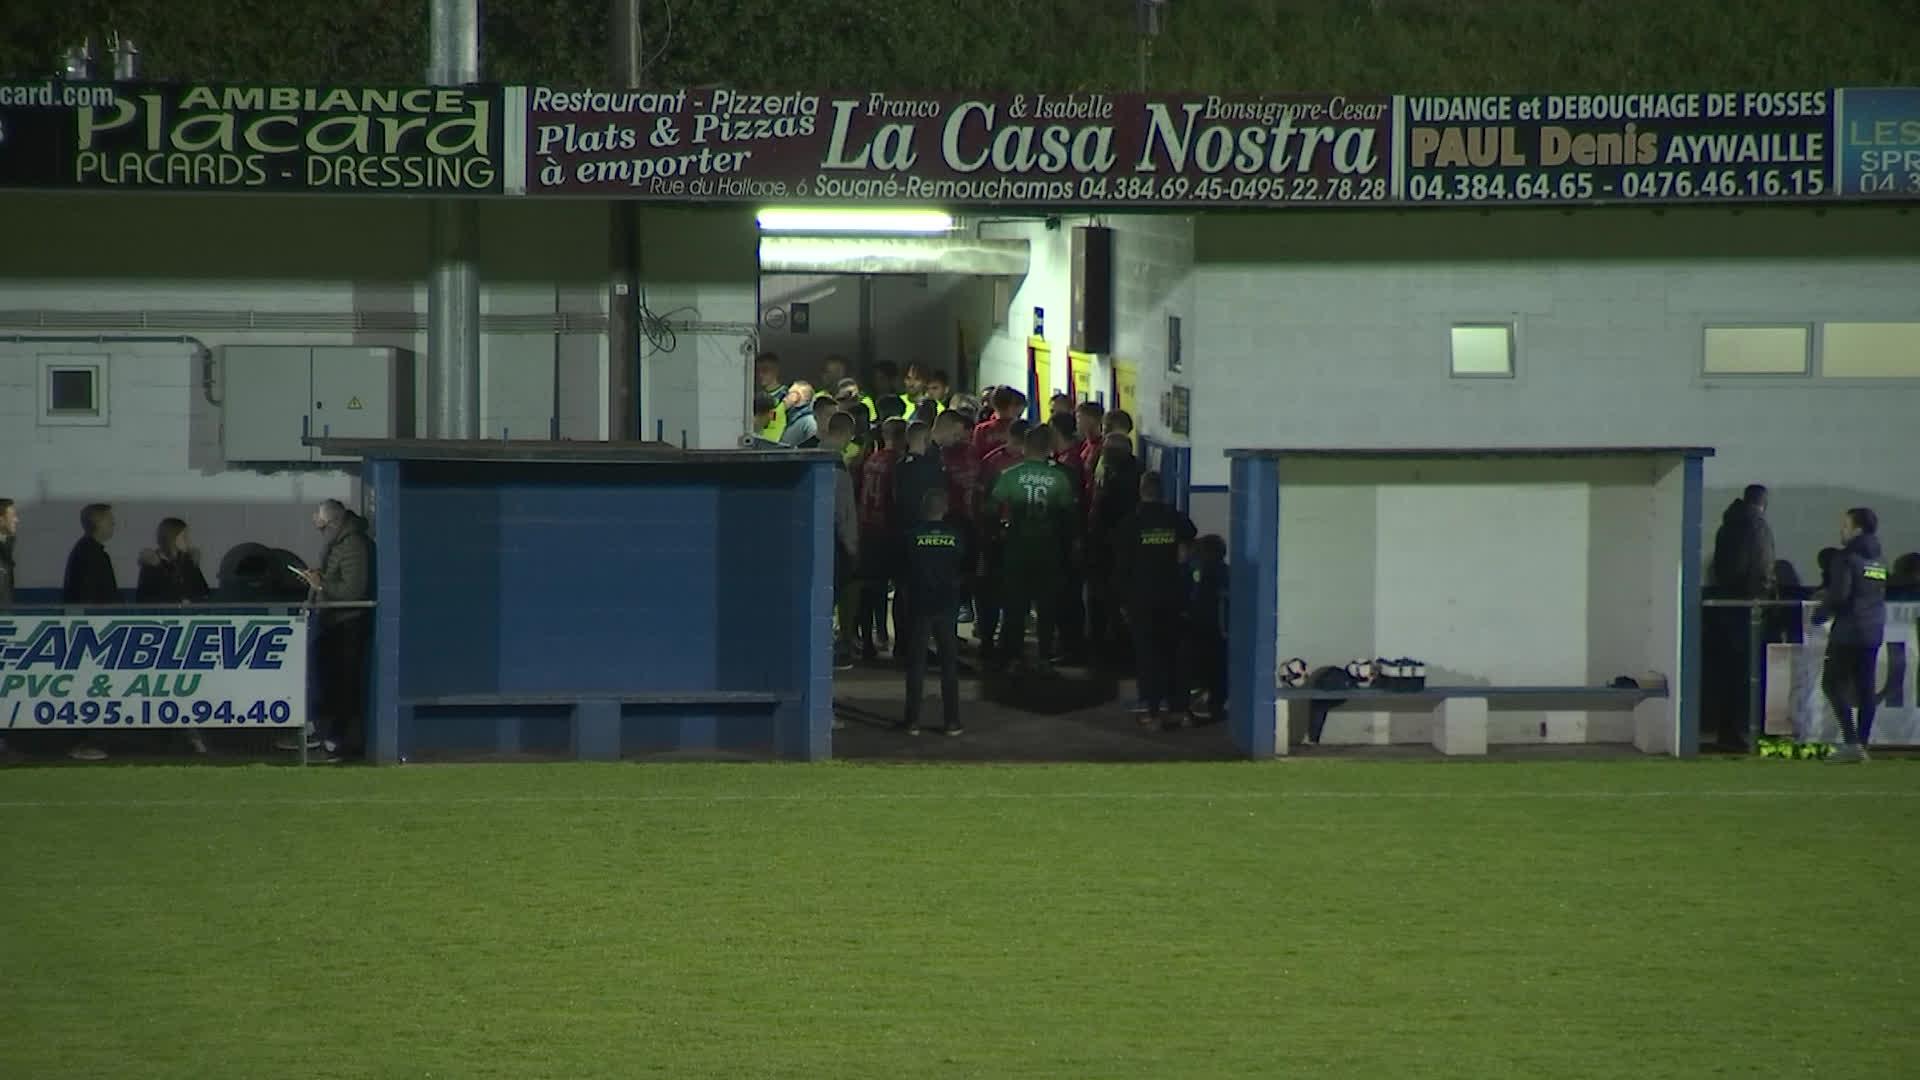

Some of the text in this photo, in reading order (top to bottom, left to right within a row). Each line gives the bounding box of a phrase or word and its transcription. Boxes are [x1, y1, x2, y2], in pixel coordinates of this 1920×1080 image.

[178, 86, 465, 113] AMBIANCE
[532, 87, 686, 113] Restaurant
[711, 90, 819, 115] Pizzeria
[866, 92, 1388, 126] Franco & Isabelle Bonsignore-Cesar
[1409, 92, 1827, 121] VIDANGE et DEBOUCHAGE DE FOSSES
[78, 94, 490, 156] Placard
[536, 112, 816, 156] Plats & Pizzas
[820, 100, 1378, 175] La Casa Nostra
[1411, 122, 1824, 168] PAUL Denis AYWAILLE
[76, 151, 267, 186] PLACARDS
[306, 155, 496, 189] DRESSING
[540, 147, 752, 187] à emporter
[650, 176, 684, 195] Rue
[689, 177, 713, 195] du
[815, 173, 1074, 200] Sougné-Remouchamps
[1079, 177, 1386, 200] 04.384.69.45-0495.22.78.28
[1409, 172, 1593, 200] 04.384.64.65
[1622, 169, 1824, 198] 0476.46.16.15
[916, 538, 956, 546] ARENA
[0, 673, 203, 698] PVC & ALU
[34, 700, 291, 726] 0495.10.94.40
